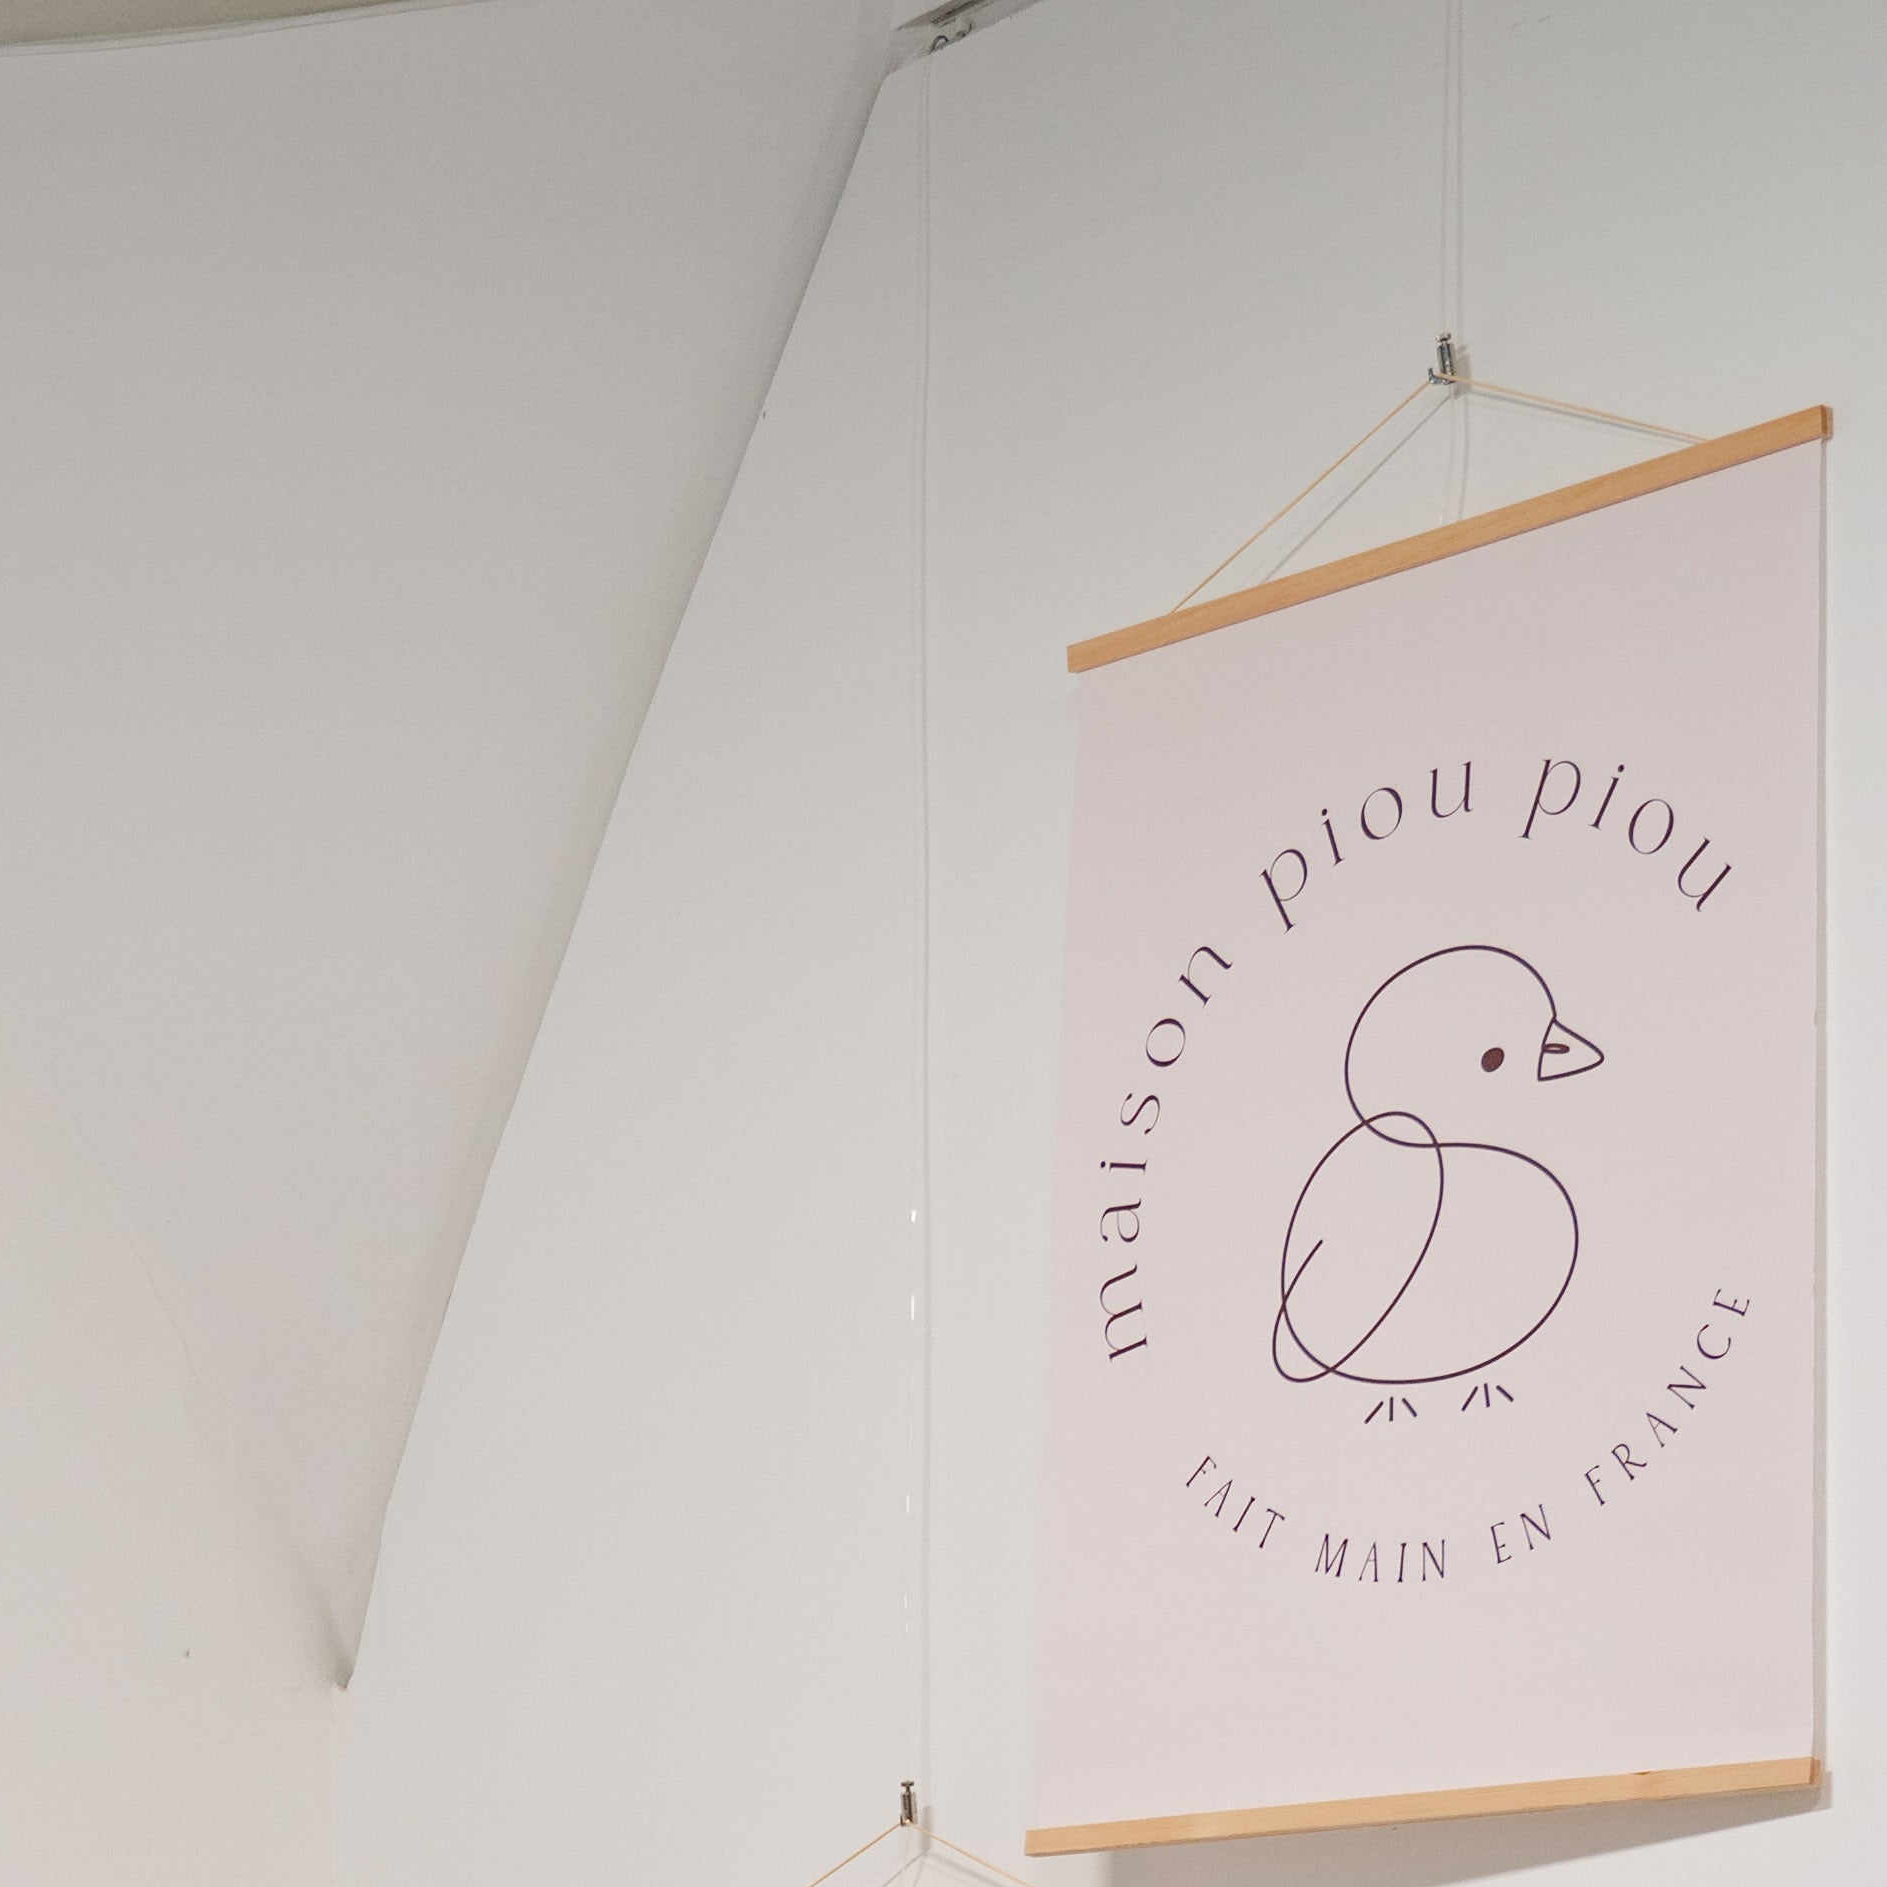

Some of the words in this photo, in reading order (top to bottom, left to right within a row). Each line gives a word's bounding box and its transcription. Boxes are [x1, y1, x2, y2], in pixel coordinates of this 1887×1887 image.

[1099, 945, 1234, 1363] maison
[1258, 760, 1474, 934] piou
[1519, 758, 1733, 913] piou
[1185, 1455, 1286, 1550] FAIT
[1314, 1532, 1446, 1584] MAIN
[1489, 1503, 1552, 1565] EN
[1583, 1288, 1751, 1507] FRANCE
